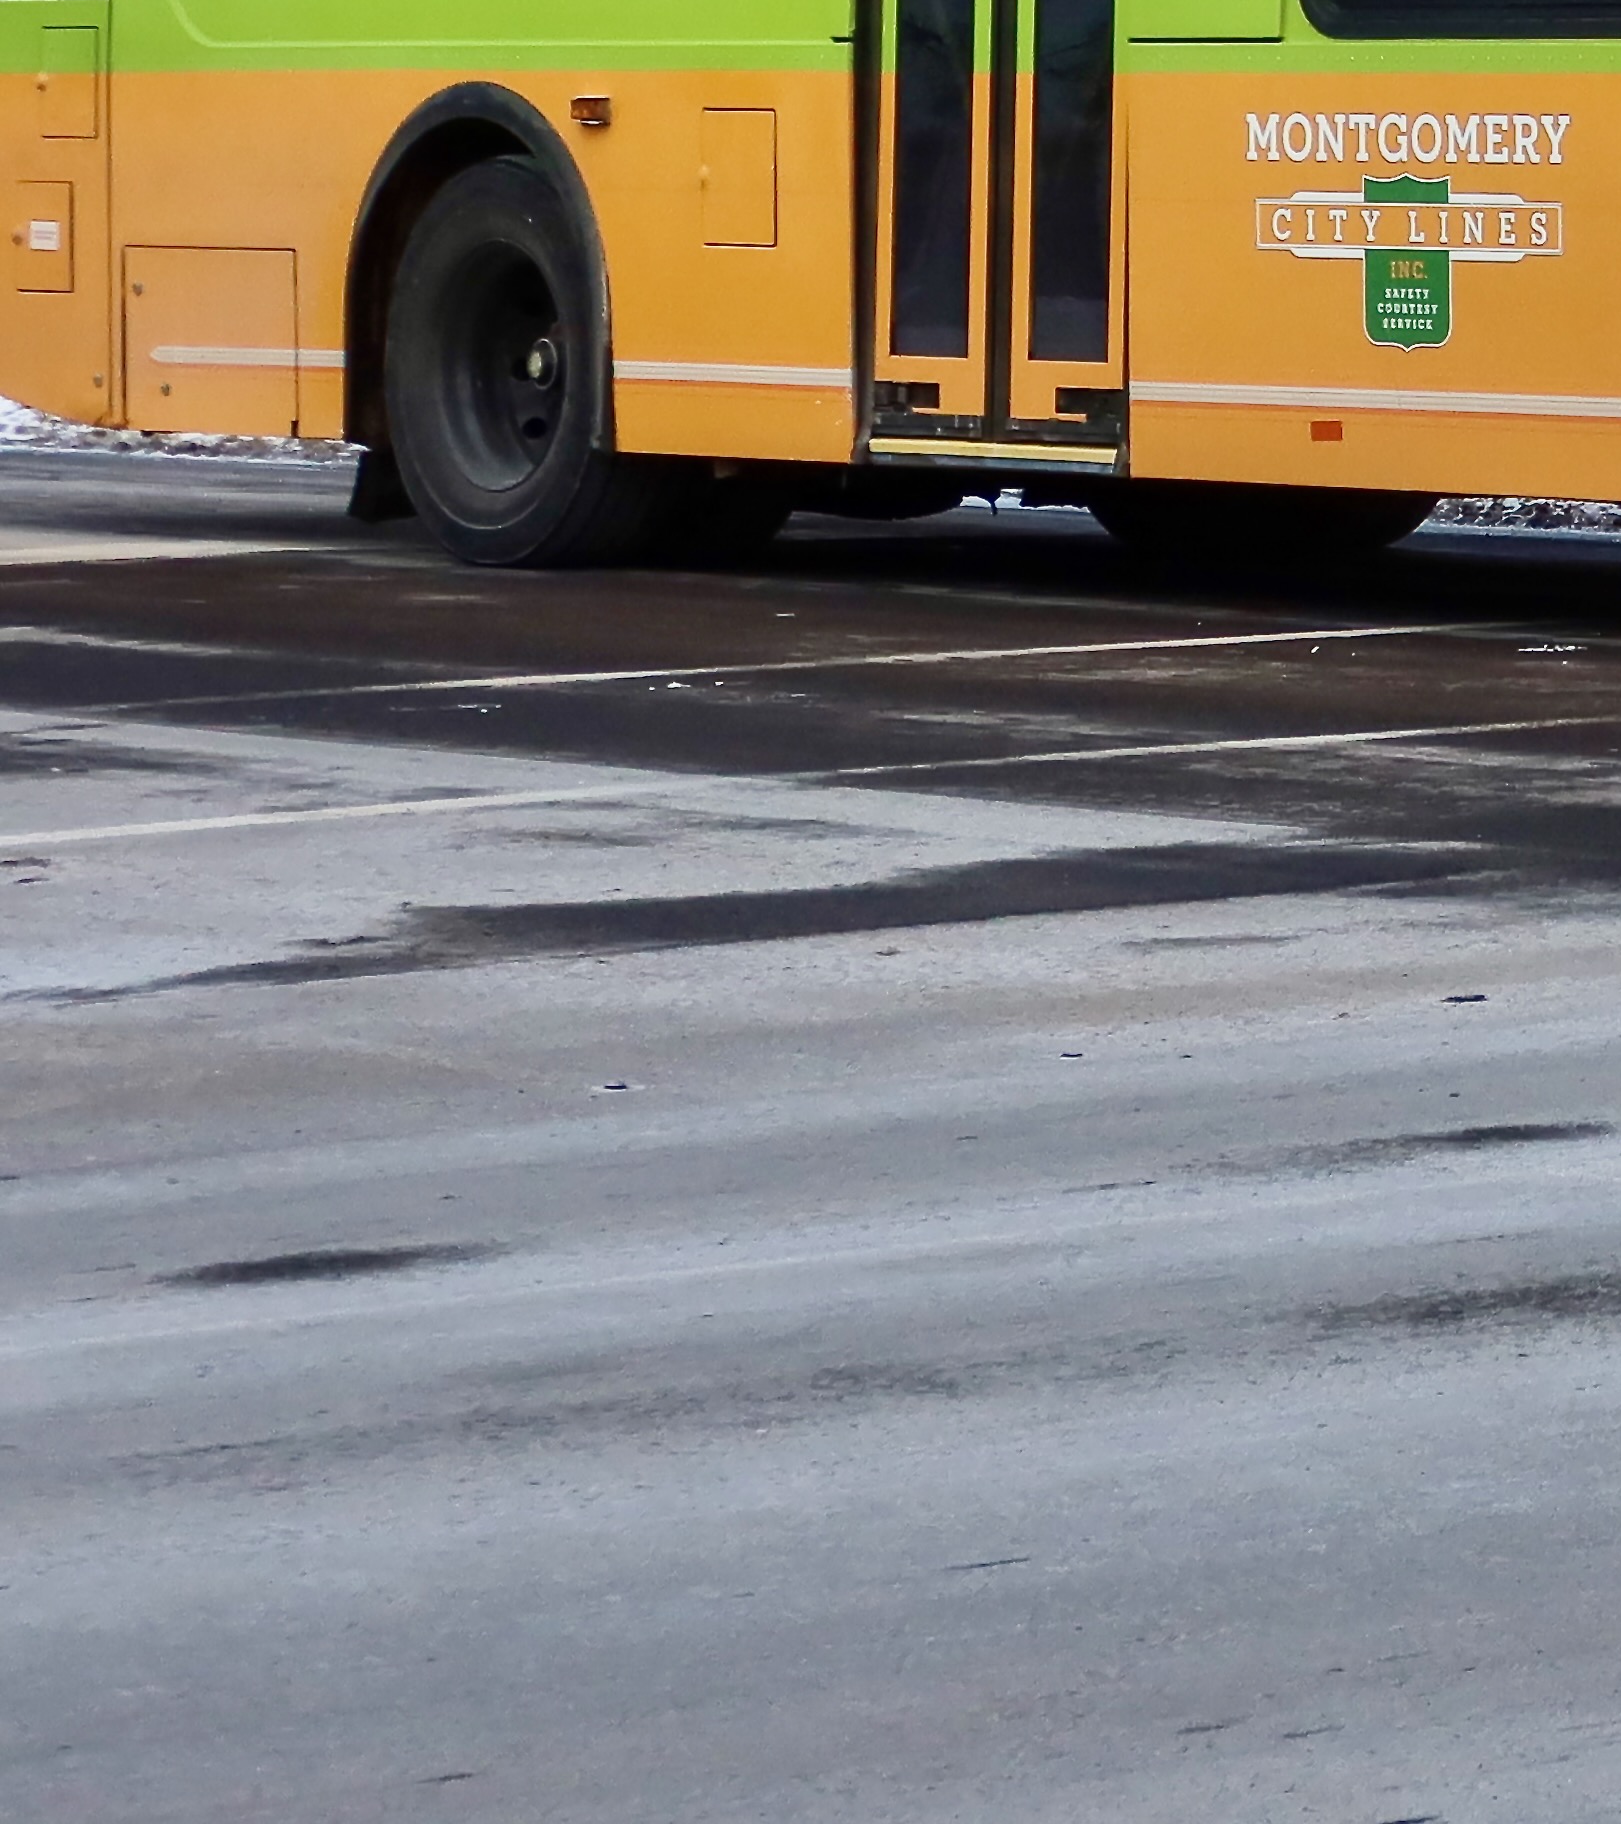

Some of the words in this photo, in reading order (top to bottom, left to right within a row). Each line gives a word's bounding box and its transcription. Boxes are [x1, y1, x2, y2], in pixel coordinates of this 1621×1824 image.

[1245, 112, 1571, 164] MONTGOMERY
[1272, 209, 1381, 242] CITY
[1407, 210, 1548, 245] LINES
[1391, 261, 1428, 279] INC.
[1384, 288, 1430, 300] SAFETY
[1377, 303, 1438, 315] COURTESY
[1382, 318, 1433, 330] SERVICE
